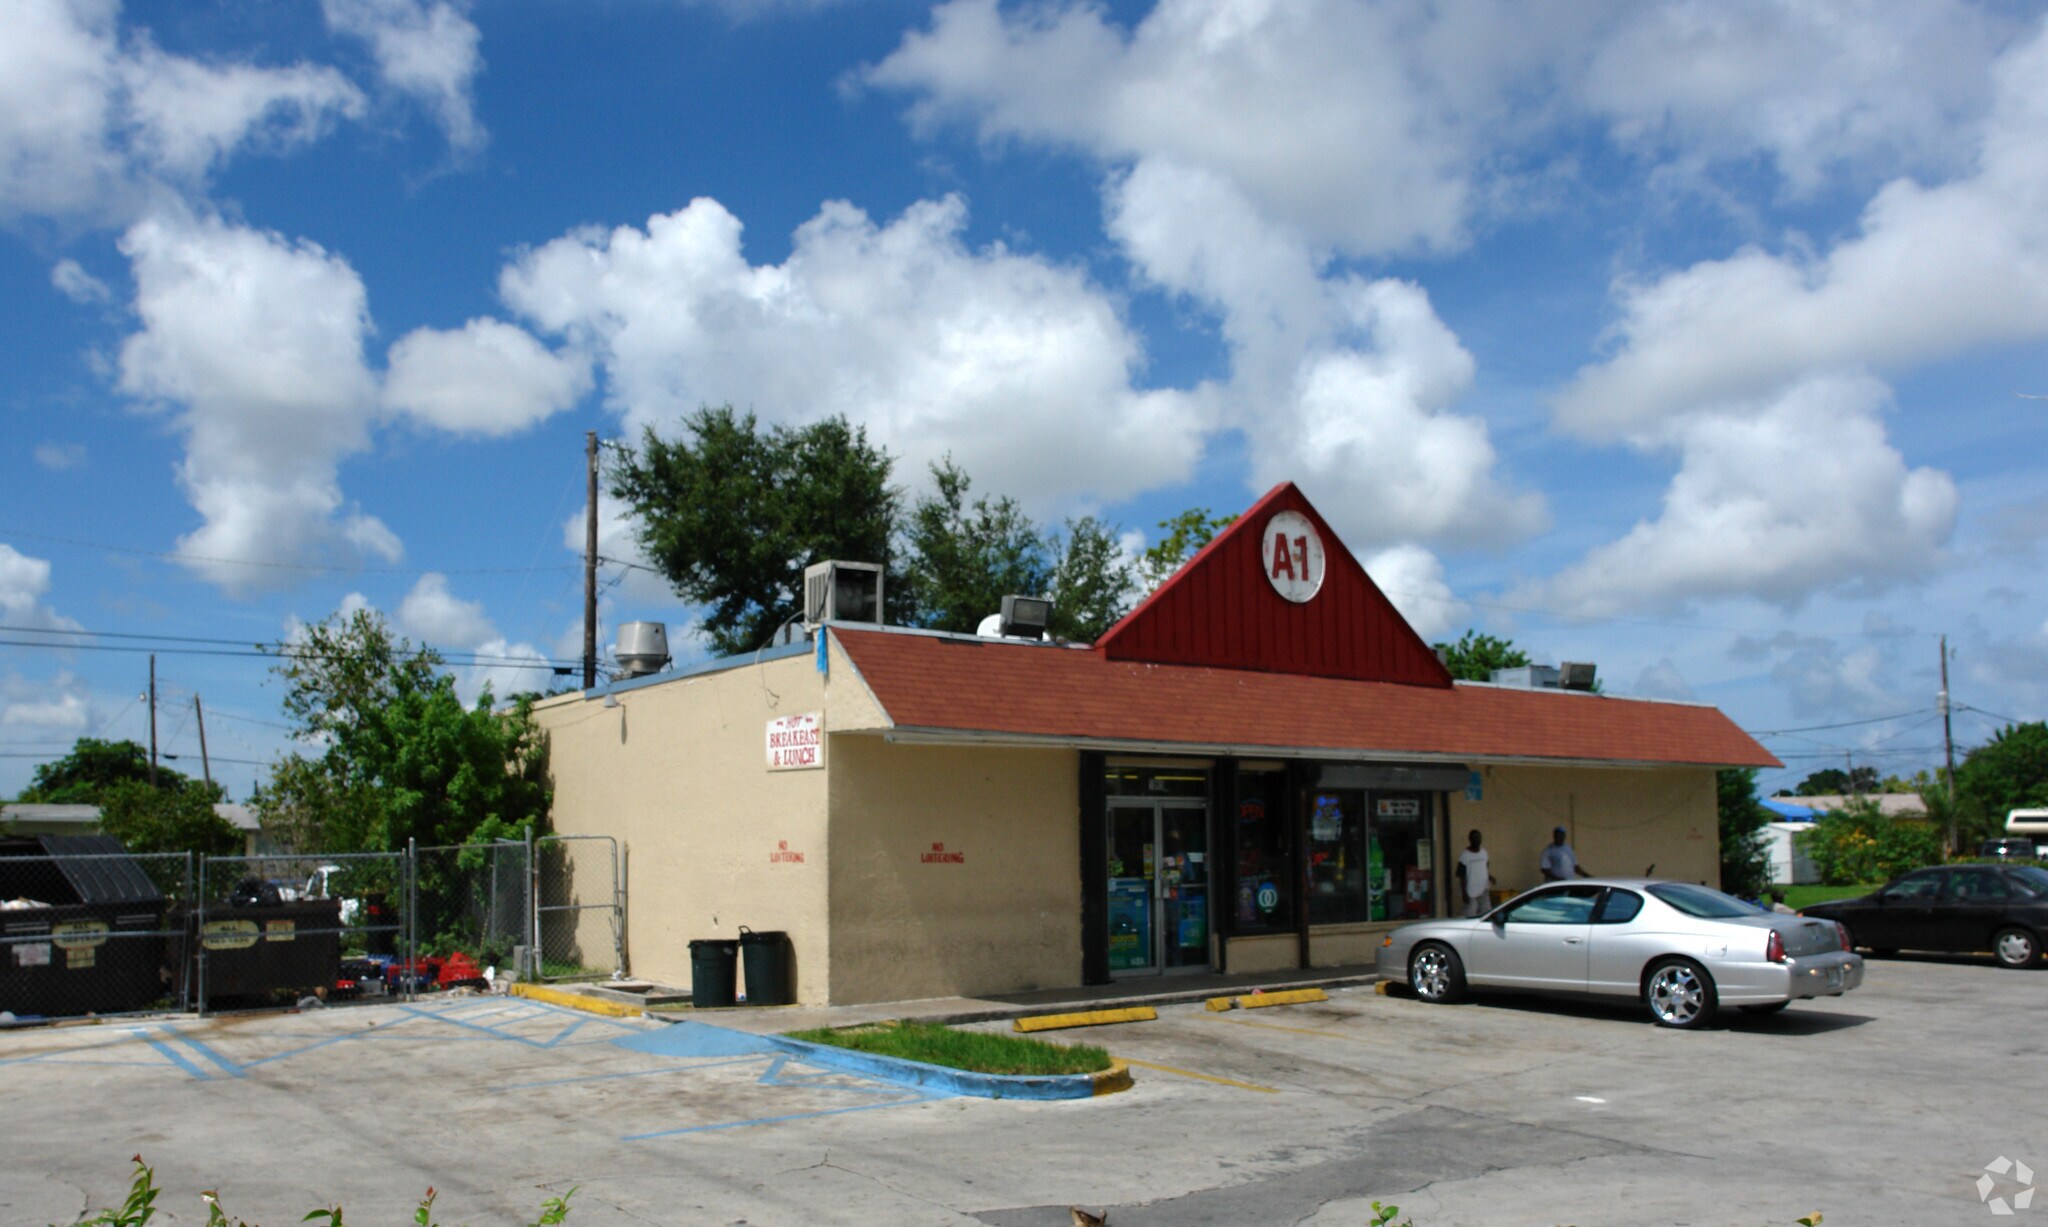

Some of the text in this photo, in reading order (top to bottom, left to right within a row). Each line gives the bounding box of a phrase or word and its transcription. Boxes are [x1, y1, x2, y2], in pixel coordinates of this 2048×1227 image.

[785, 715, 803, 729] HOT
[769, 727, 820, 748] BREAKFAST
[773, 747, 815, 766] & LUNCH
[778, 840, 788, 850] NO
[932, 842, 944, 852] NO
[770, 851, 805, 864] LOITERING
[920, 852, 964, 864] LOITERING
